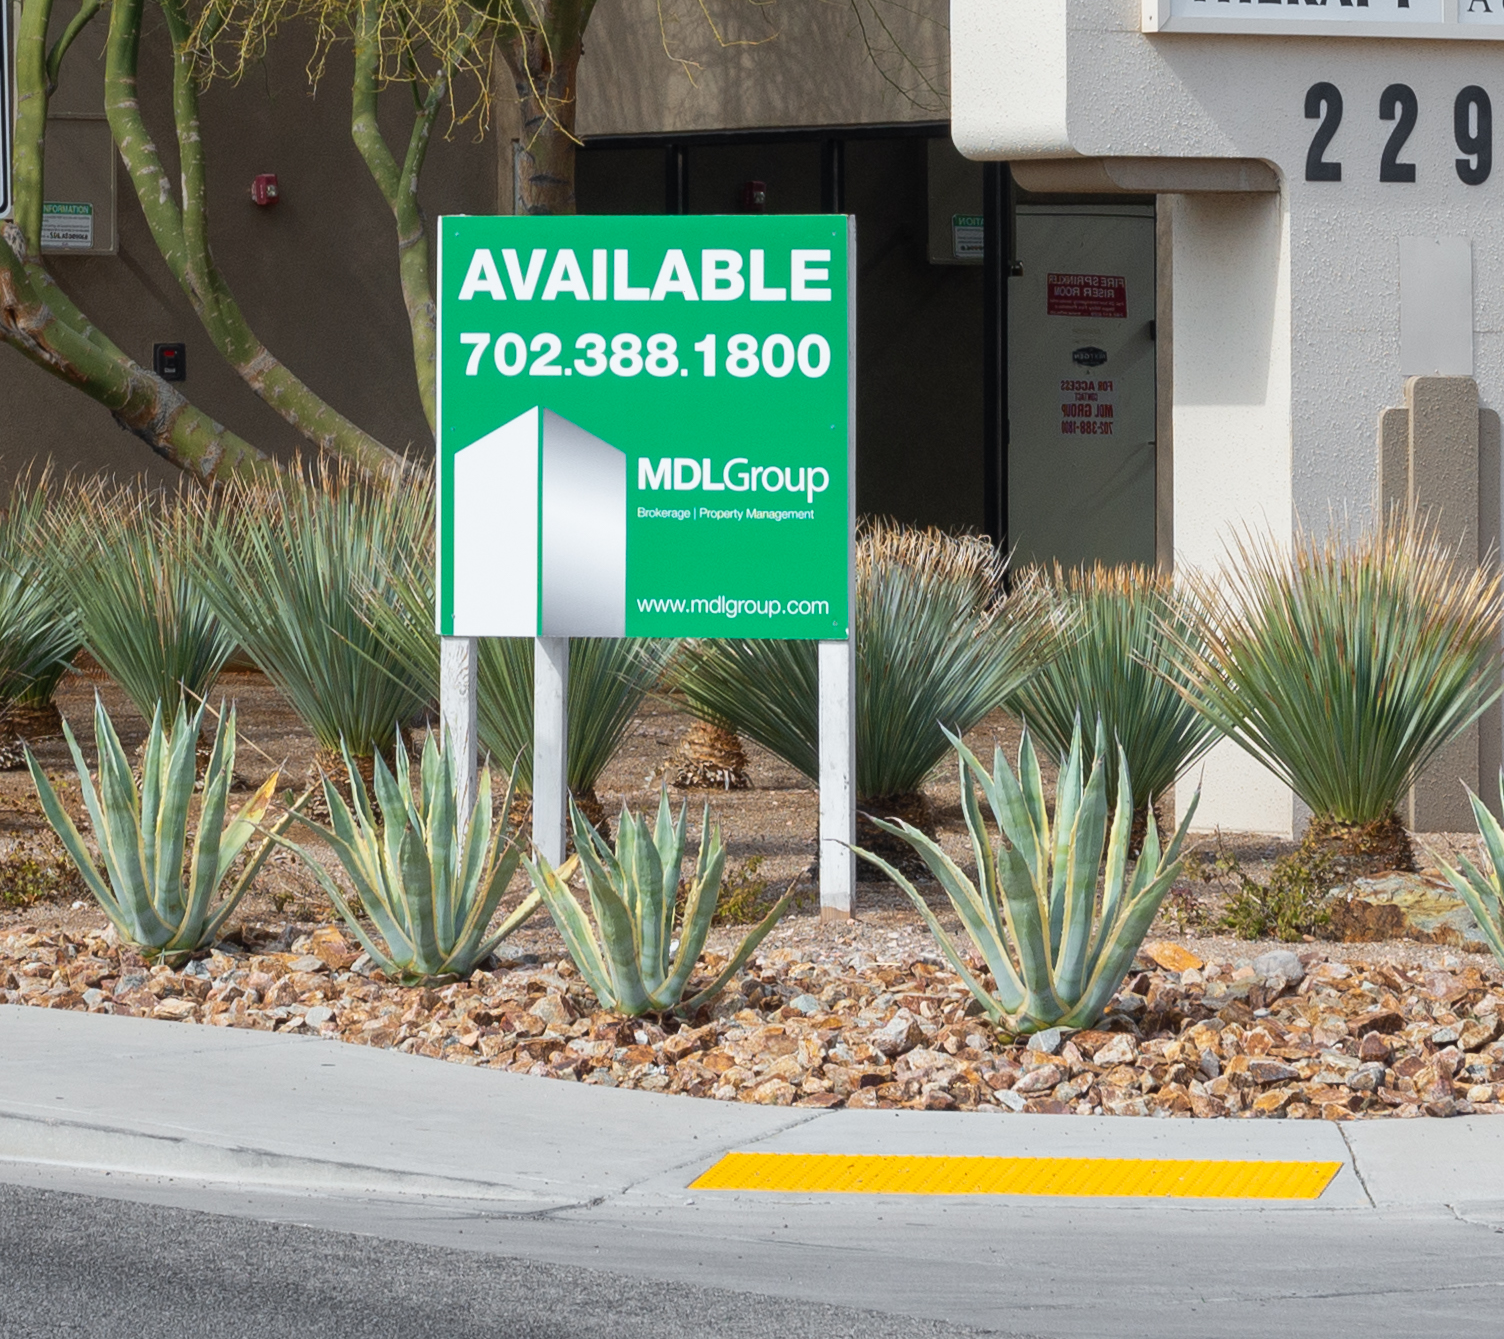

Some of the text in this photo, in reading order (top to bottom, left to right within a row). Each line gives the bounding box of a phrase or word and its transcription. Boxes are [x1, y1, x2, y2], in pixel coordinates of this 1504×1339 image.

[43, 204, 89, 214] NFORMATION
[458, 248, 832, 302] AVAILABLE
[459, 332, 831, 378] 702.388.1800
[637, 457, 830, 503] MDLGroup
[637, 507, 815, 522] Brokerage Property Management
[636, 595, 830, 618] www.mdlgroup.com
